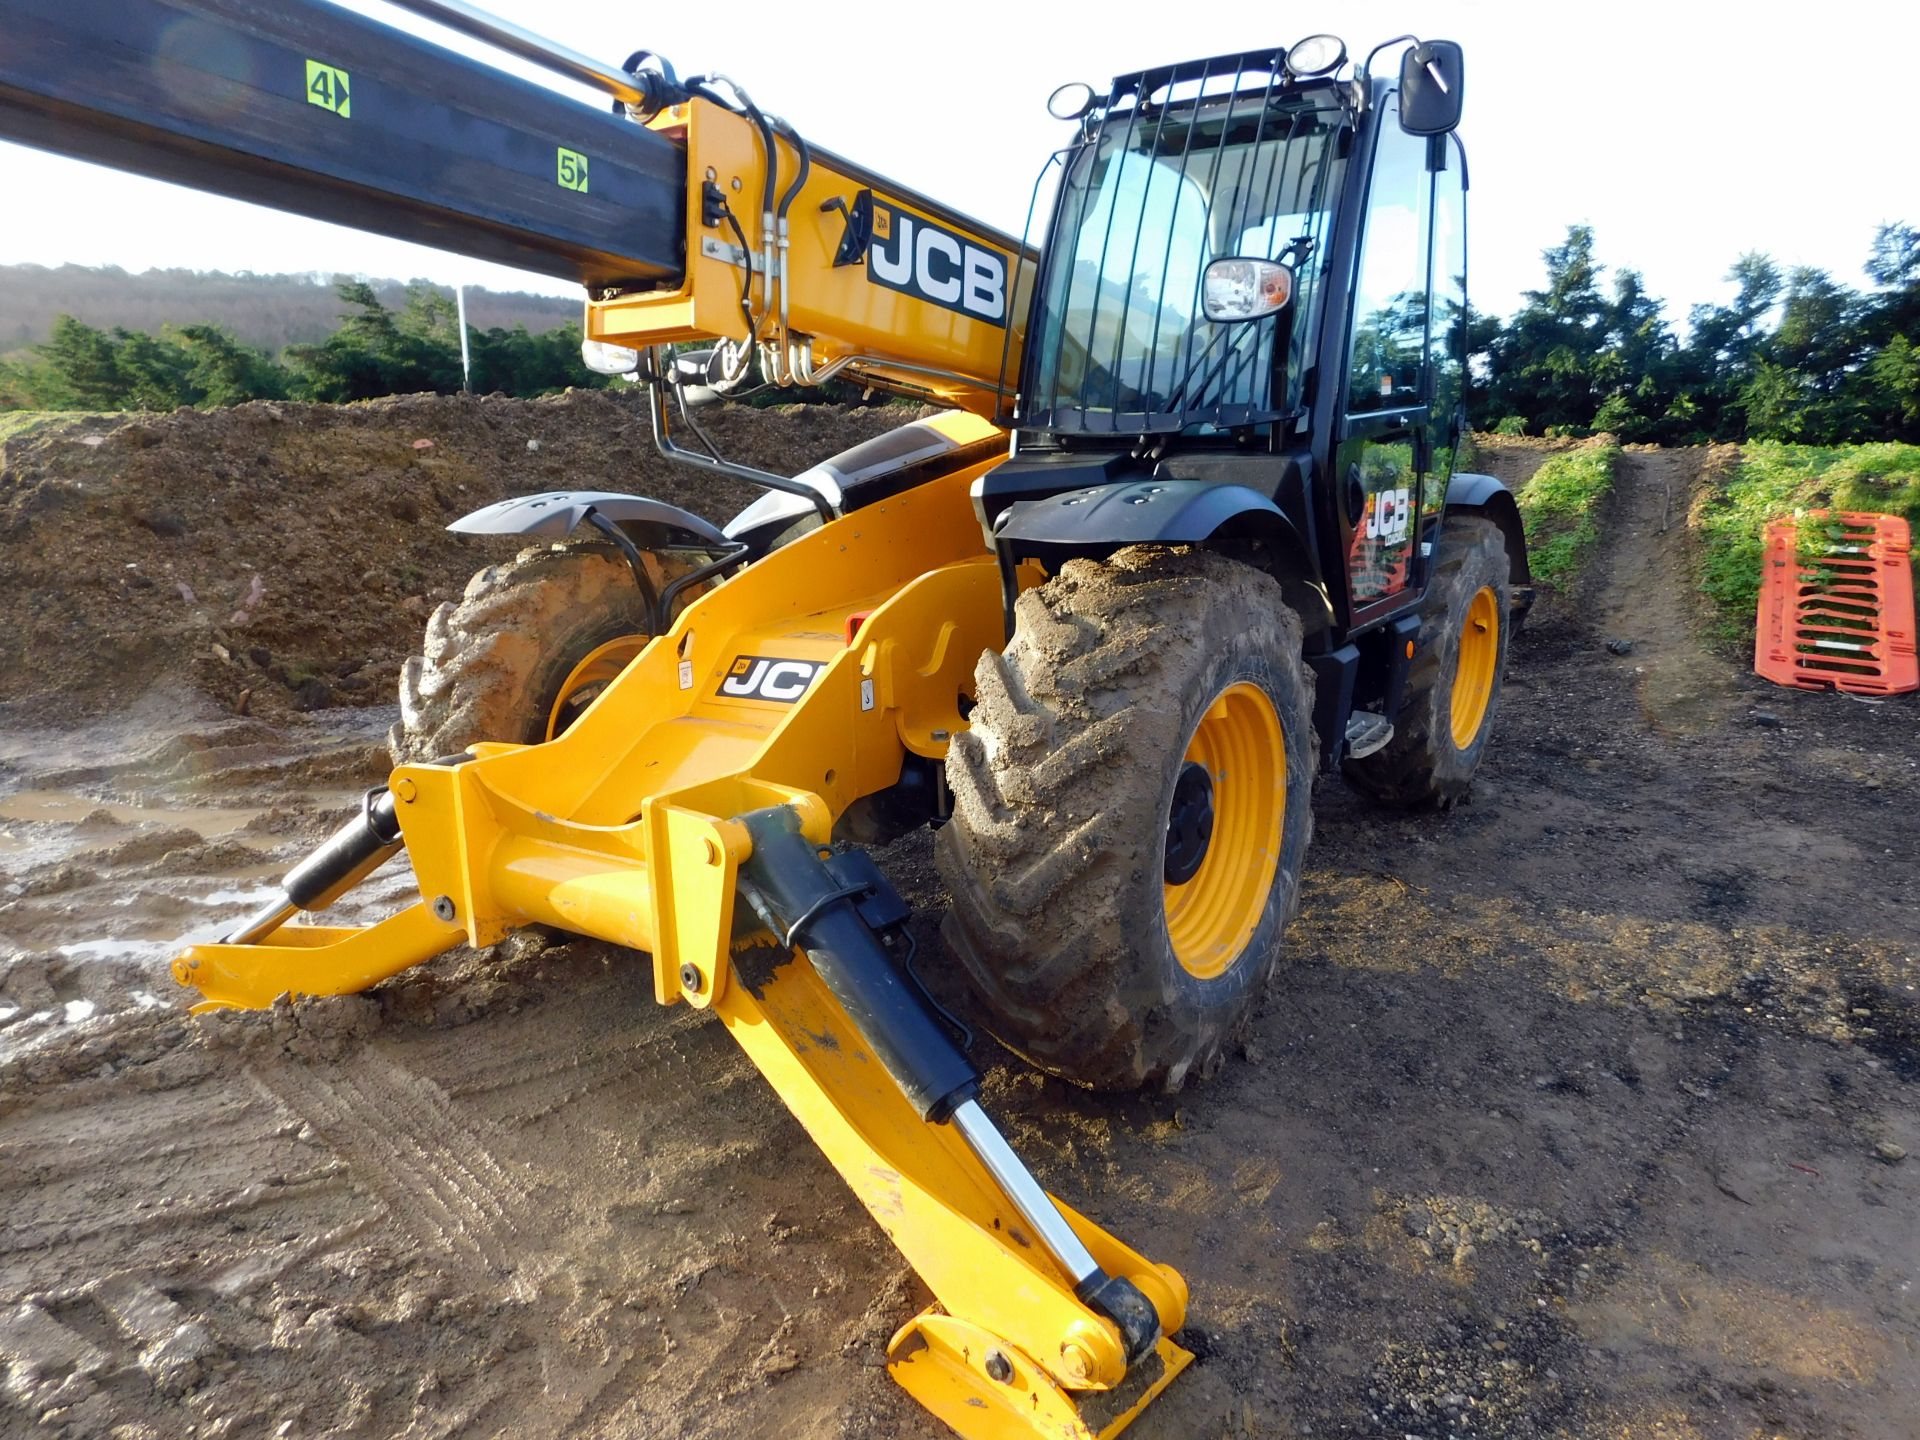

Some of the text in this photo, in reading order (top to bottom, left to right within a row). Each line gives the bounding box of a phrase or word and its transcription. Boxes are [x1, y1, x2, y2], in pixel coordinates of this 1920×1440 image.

[310, 70, 332, 105] 4
[559, 156, 575, 184] 5
[871, 216, 1004, 319] JCB
[1367, 489, 1409, 539] JCB
